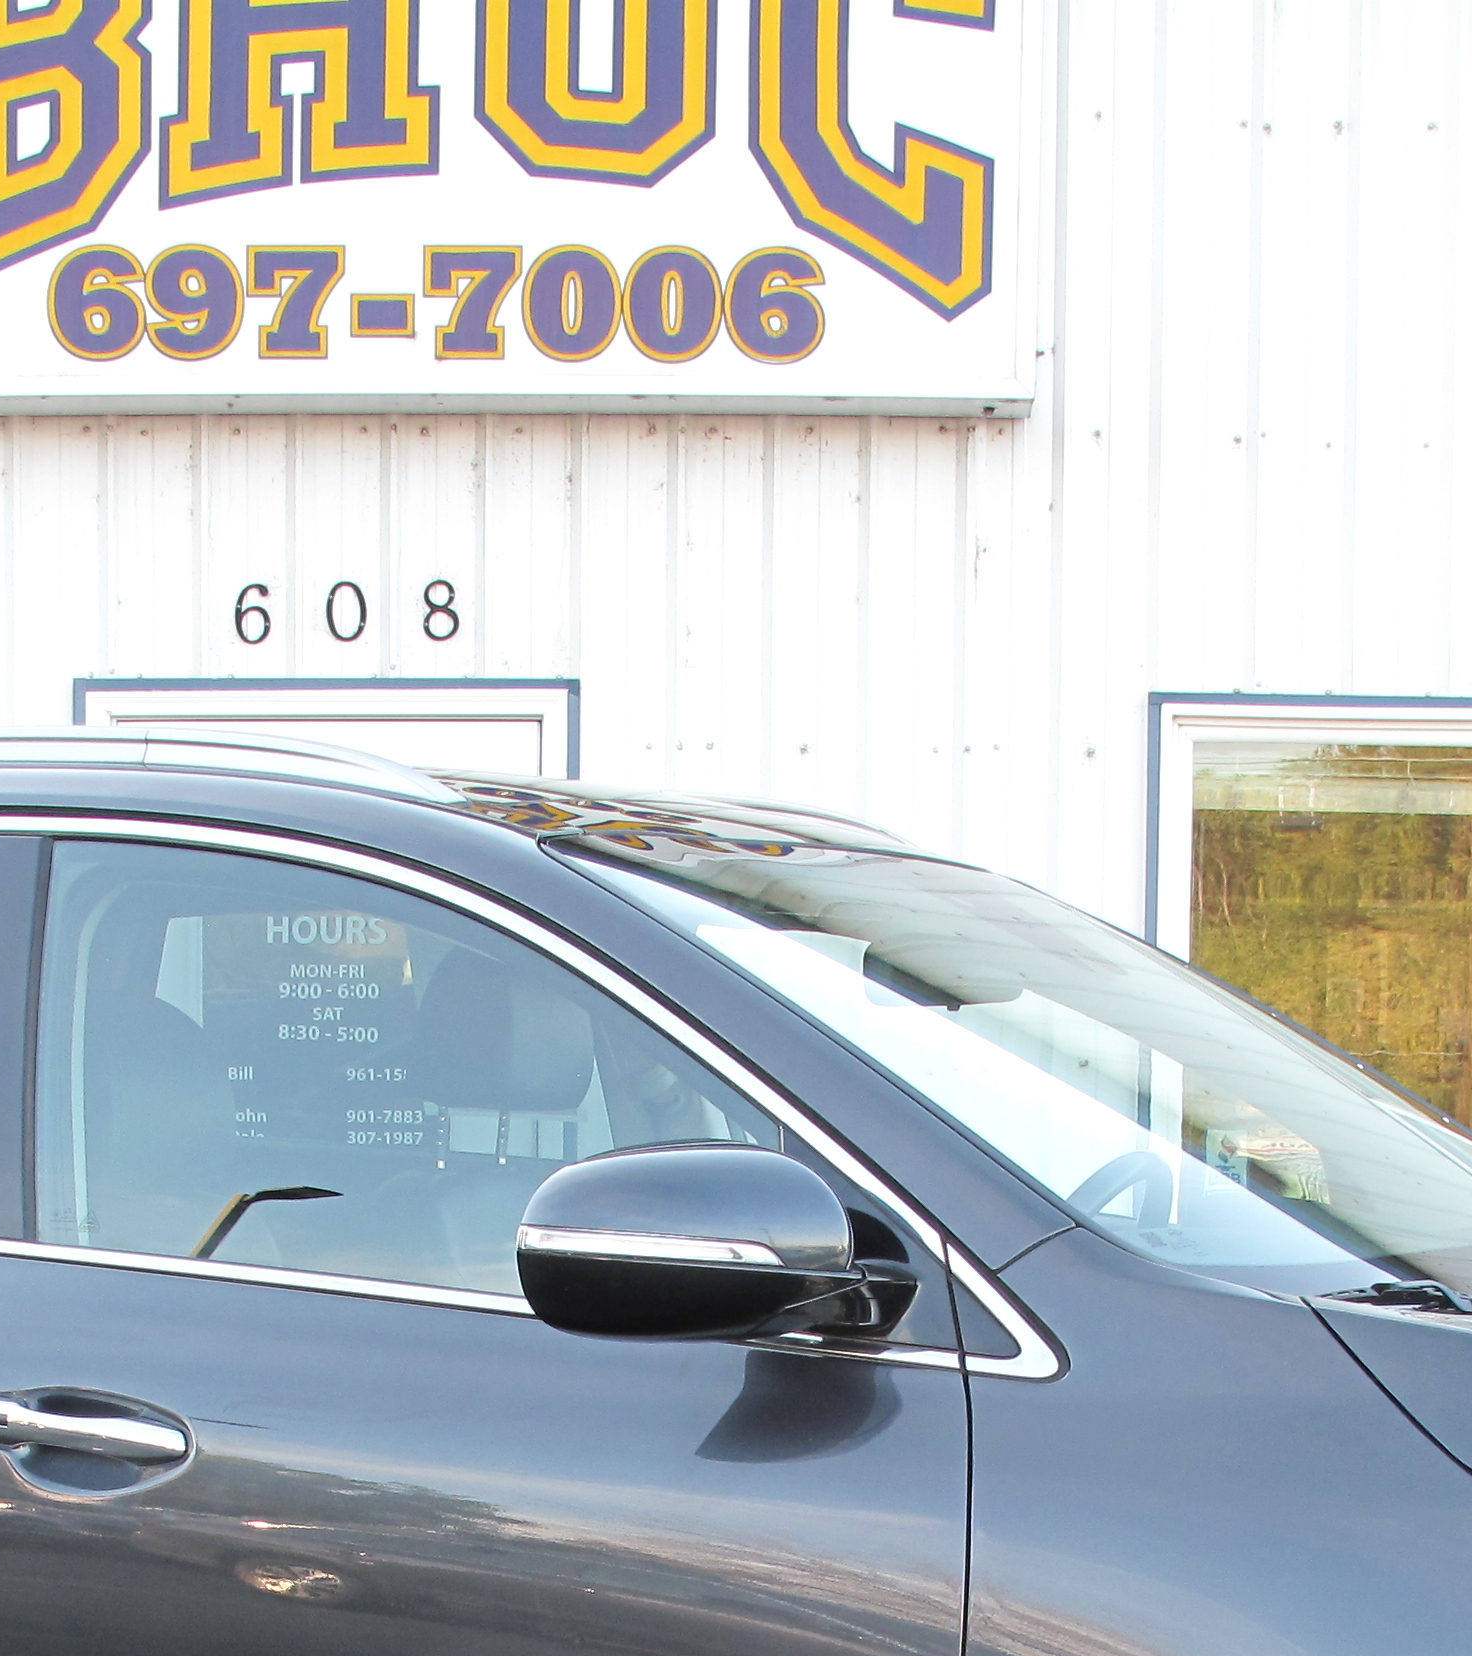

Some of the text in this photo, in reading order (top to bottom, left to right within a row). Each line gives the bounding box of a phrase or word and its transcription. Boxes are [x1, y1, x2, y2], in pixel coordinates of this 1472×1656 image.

[47, 243, 827, 364] 697-7006
[266, 915, 388, 945] HOURS
[289, 964, 366, 979] MON-FRI
[278, 982, 323, 999] 9:00
[337, 983, 380, 999] 6:00
[312, 1006, 345, 1021] SAT
[278, 1024, 320, 1041] 8:30
[336, 1026, 379, 1043] 5:00
[228, 1066, 254, 1081] Bill
[235, 1108, 424, 1124] ohn 901-7883
[346, 1131, 424, 1145] 307-1987
